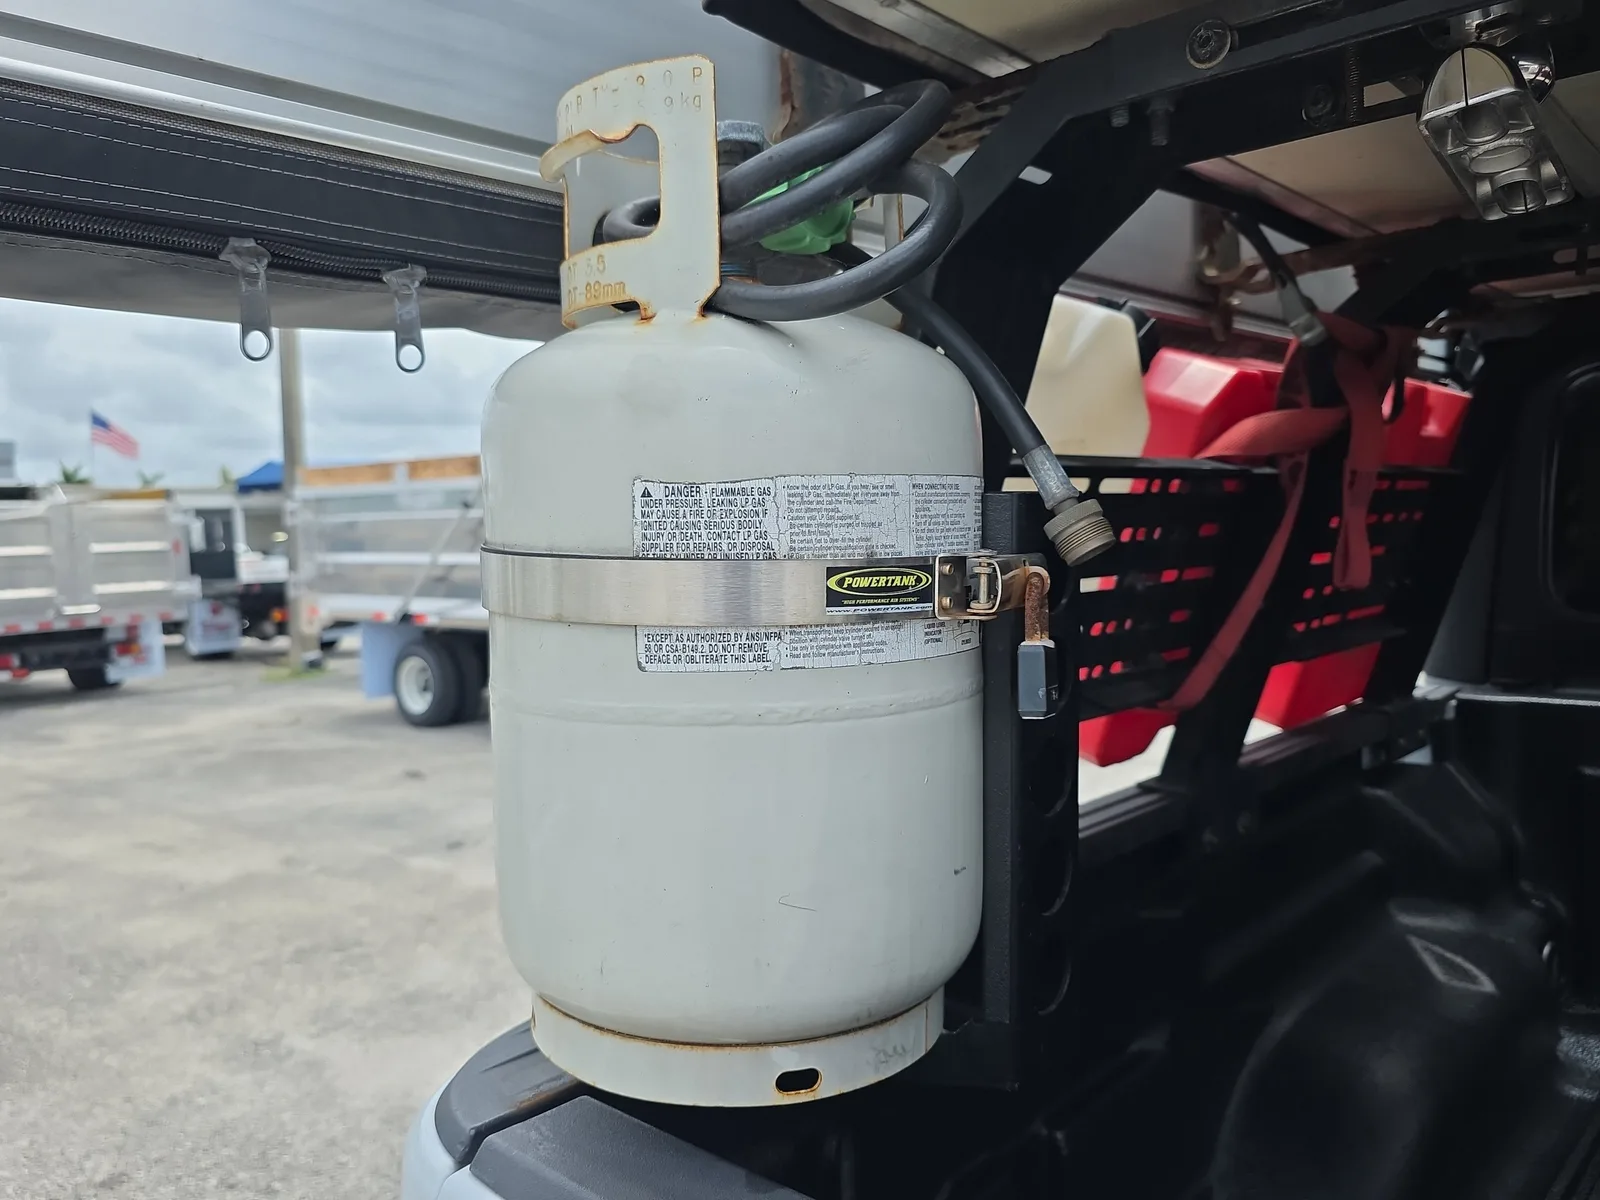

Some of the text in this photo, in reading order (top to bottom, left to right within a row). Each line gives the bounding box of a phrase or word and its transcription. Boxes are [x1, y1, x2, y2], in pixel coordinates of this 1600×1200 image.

[664, 485, 771, 498] DANGER FLAMMABLE GAS
[640, 499, 663, 509] UNDER
[707, 498, 738, 508] LEAKING
[740, 497, 749, 508] LP
[752, 497, 766, 508] GAS
[641, 509, 654, 519] MAY
[656, 509, 680, 519] CAUSE
[682, 509, 688, 519] A
[689, 509, 705, 519] FIRE
[720, 508, 760, 519] EXPLOSION
[762, 508, 768, 519] IF
[641, 519, 763, 531] IGNITED CAUSING SERIOUS BODILY
[641, 530, 768, 541] INJURY OR DEATH. CONTACT LP GAS
[642, 542, 674, 552] SUPPLIER
[676, 542, 690, 552] FOR
[727, 541, 738, 552] OR
[740, 541, 775, 551] DISPOSAL
[842, 575, 917, 588] POWERTANK
[826, 605, 932, 614] www.POWERTANK.com
[675, 633, 685, 643] AS
[686, 632, 732, 643] AUTHORIZED
[733, 632, 744, 642] BY
[745, 631, 782, 642] ANSI/NFPA
[645, 644, 652, 653] 58
[654, 644, 663, 653] OR
[709, 643, 719, 653] DO
[722, 643, 736, 653] NOT
[645, 653, 772, 664] DEFACE OR OBLITERATE THIS LABEL.
